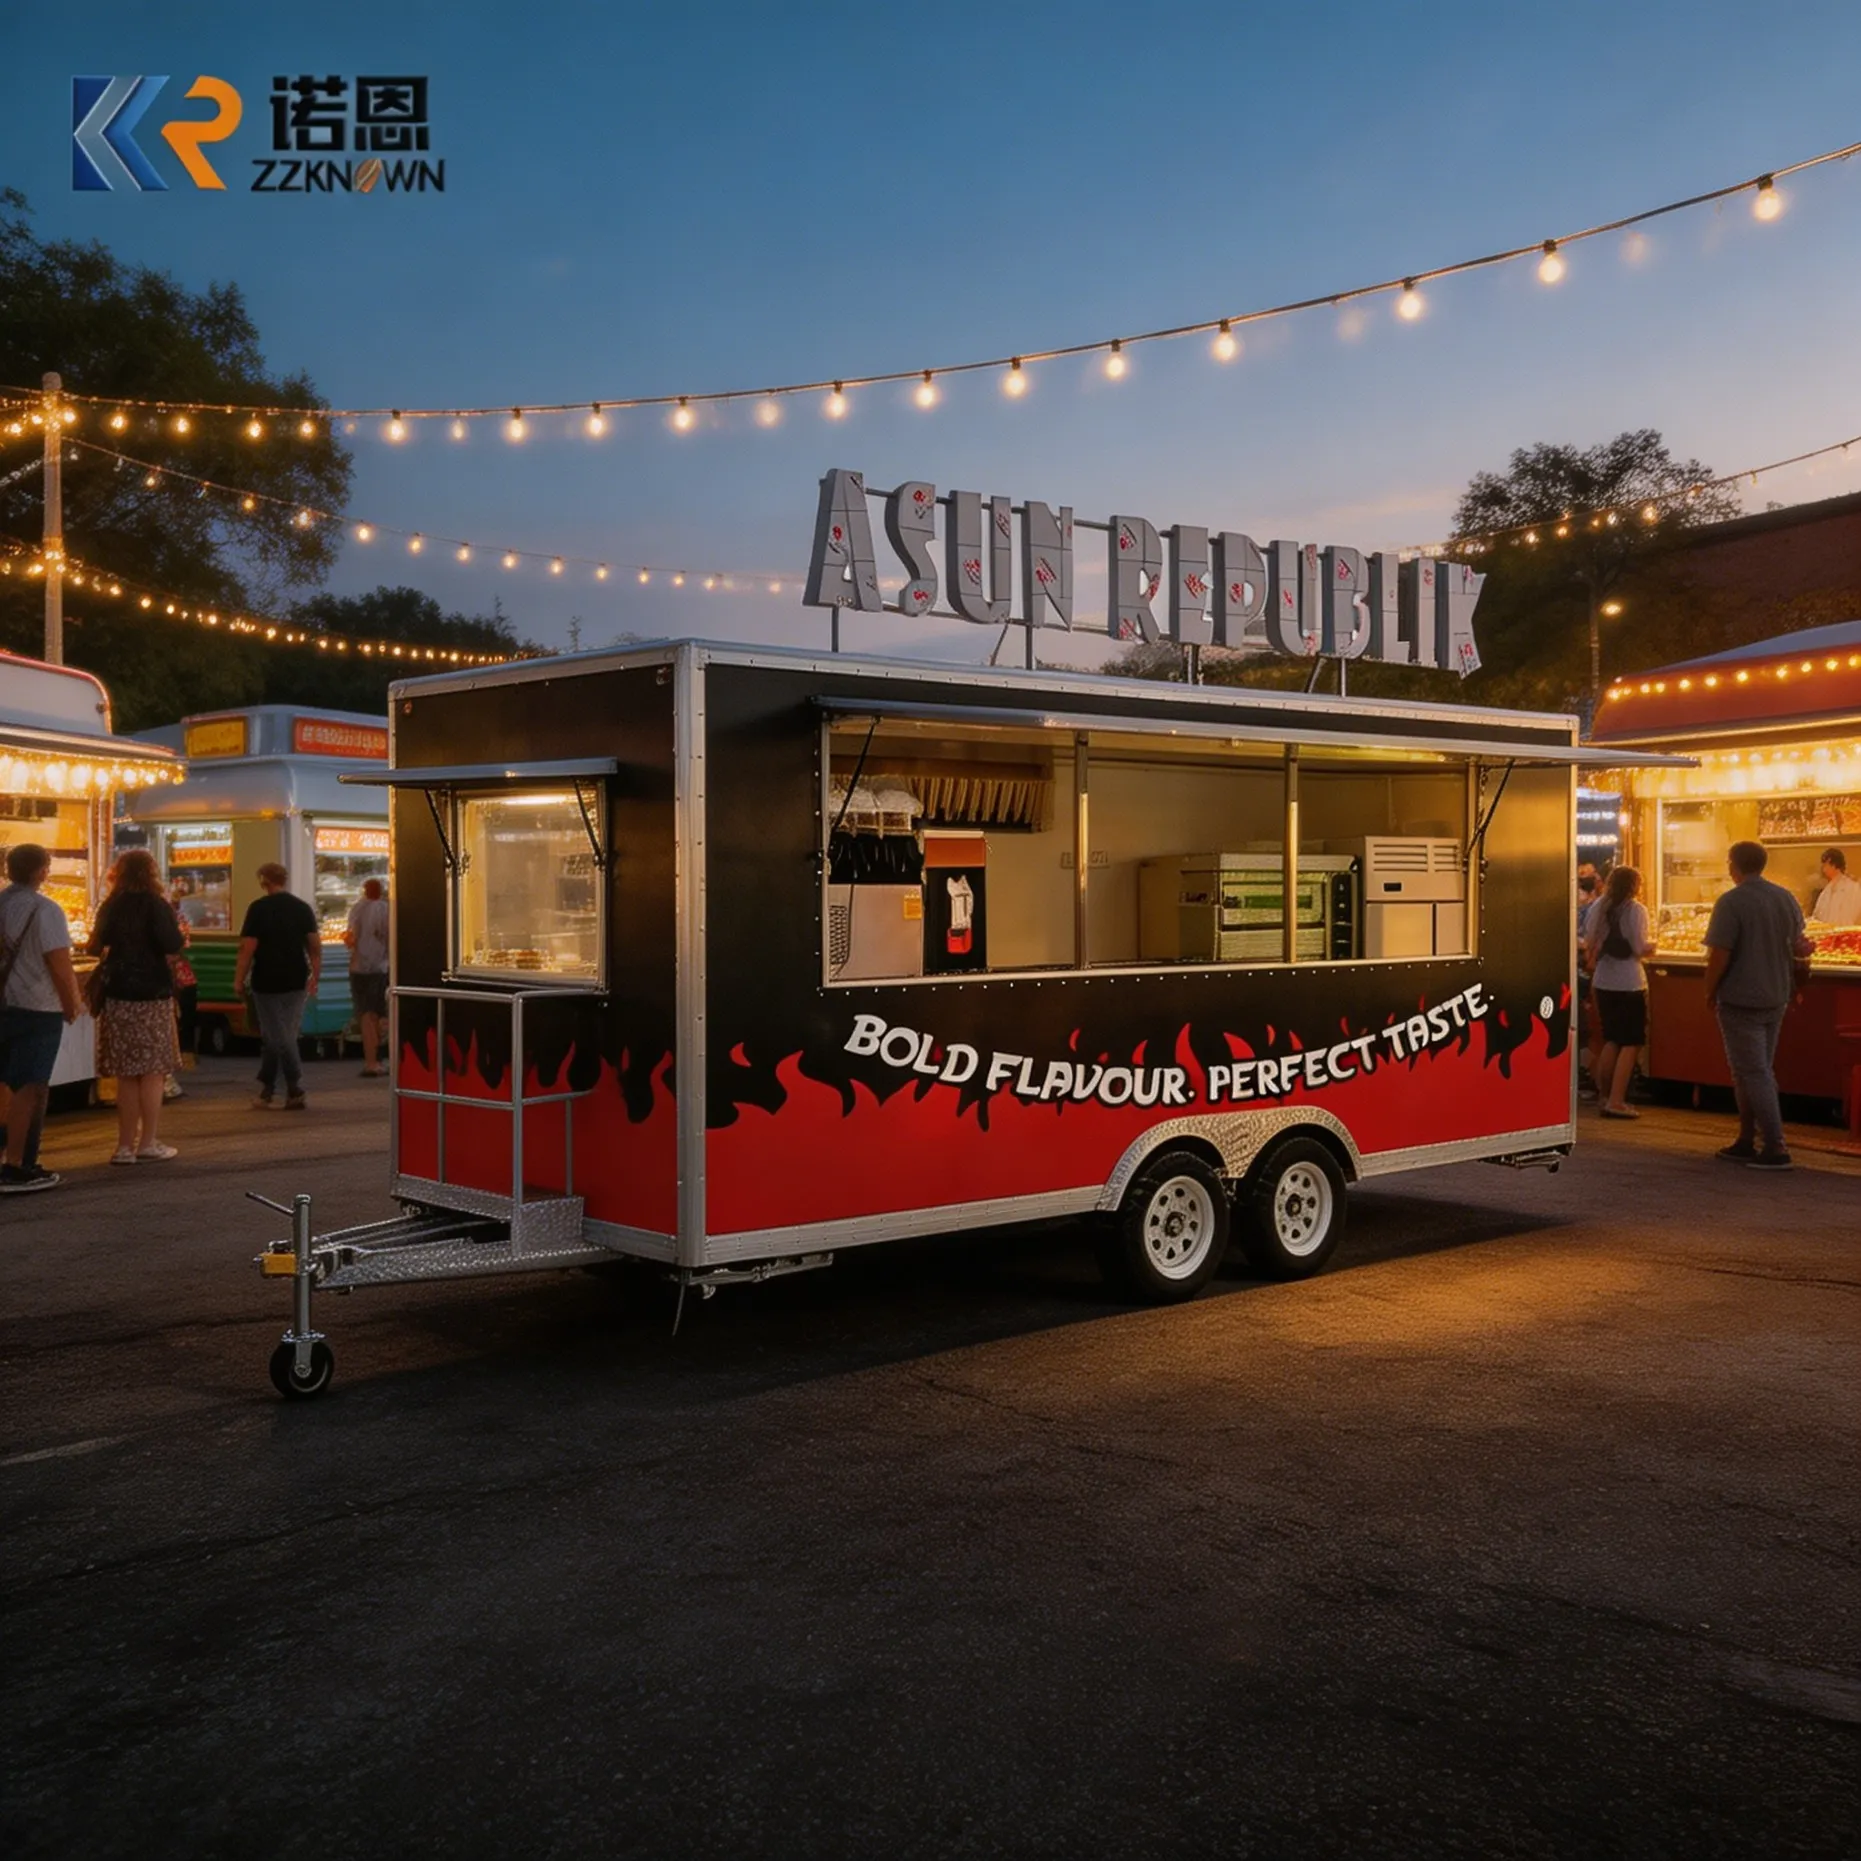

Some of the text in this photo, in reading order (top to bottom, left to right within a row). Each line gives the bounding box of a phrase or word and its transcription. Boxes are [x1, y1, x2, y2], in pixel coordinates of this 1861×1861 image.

[803, 468, 1486, 677] ASUN REPUBLIK
[844, 983, 1495, 1105] BOLD FLAVOUR. PERFECT TASTE.
